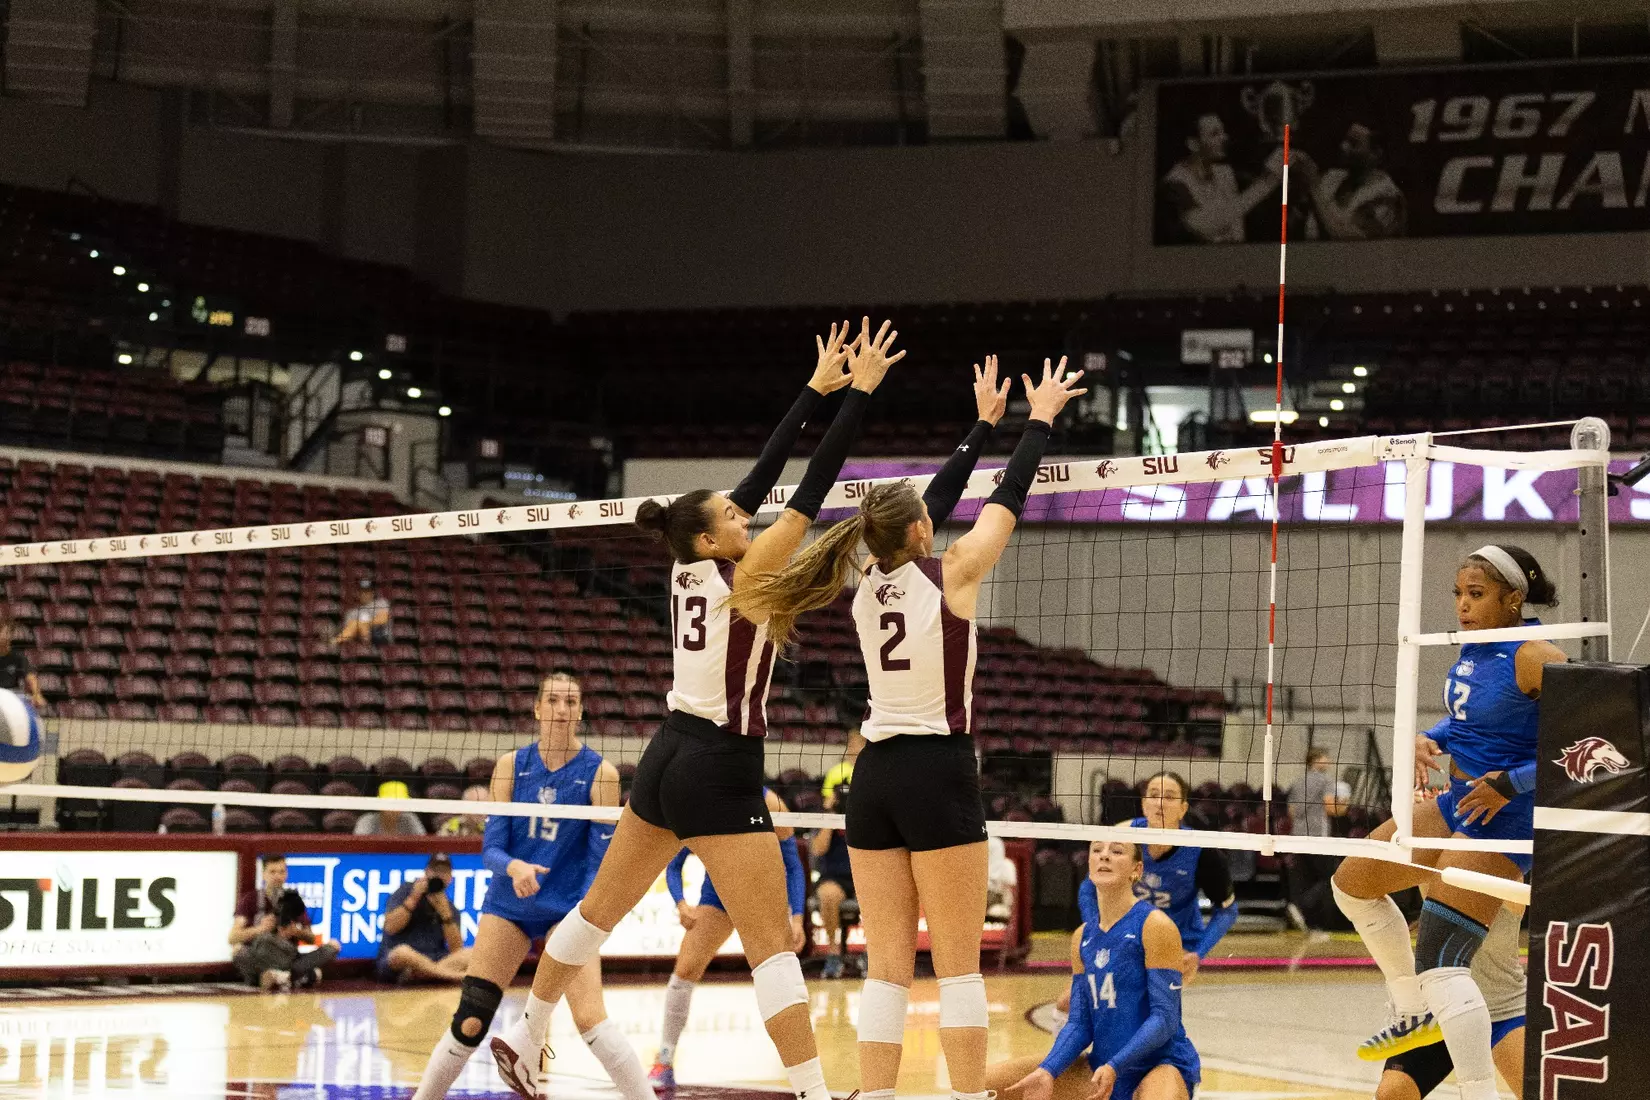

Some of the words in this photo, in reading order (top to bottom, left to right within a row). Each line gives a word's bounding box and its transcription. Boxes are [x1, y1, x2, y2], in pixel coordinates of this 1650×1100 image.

[1409, 90, 1596, 143] 1967
[1257, 446, 1296, 465] SU
[1142, 455, 1179, 475] SIU
[1036, 465, 1070, 484] SIU
[527, 507, 550, 522] SIU
[600, 502, 624, 517] SIU
[392, 517, 413, 532] SIU
[458, 513, 479, 527] SIU
[272, 527, 290, 540] SIU
[330, 522, 350, 536] SIU
[110, 539, 127, 551] SIU
[162, 536, 178, 548] SIU
[215, 532, 233, 544] SIU
[14, 546, 29, 557] SIU
[61, 543, 76, 554] SIU
[673, 595, 707, 651] 13
[879, 612, 911, 671] 2
[1088, 972, 1117, 1009] 14
